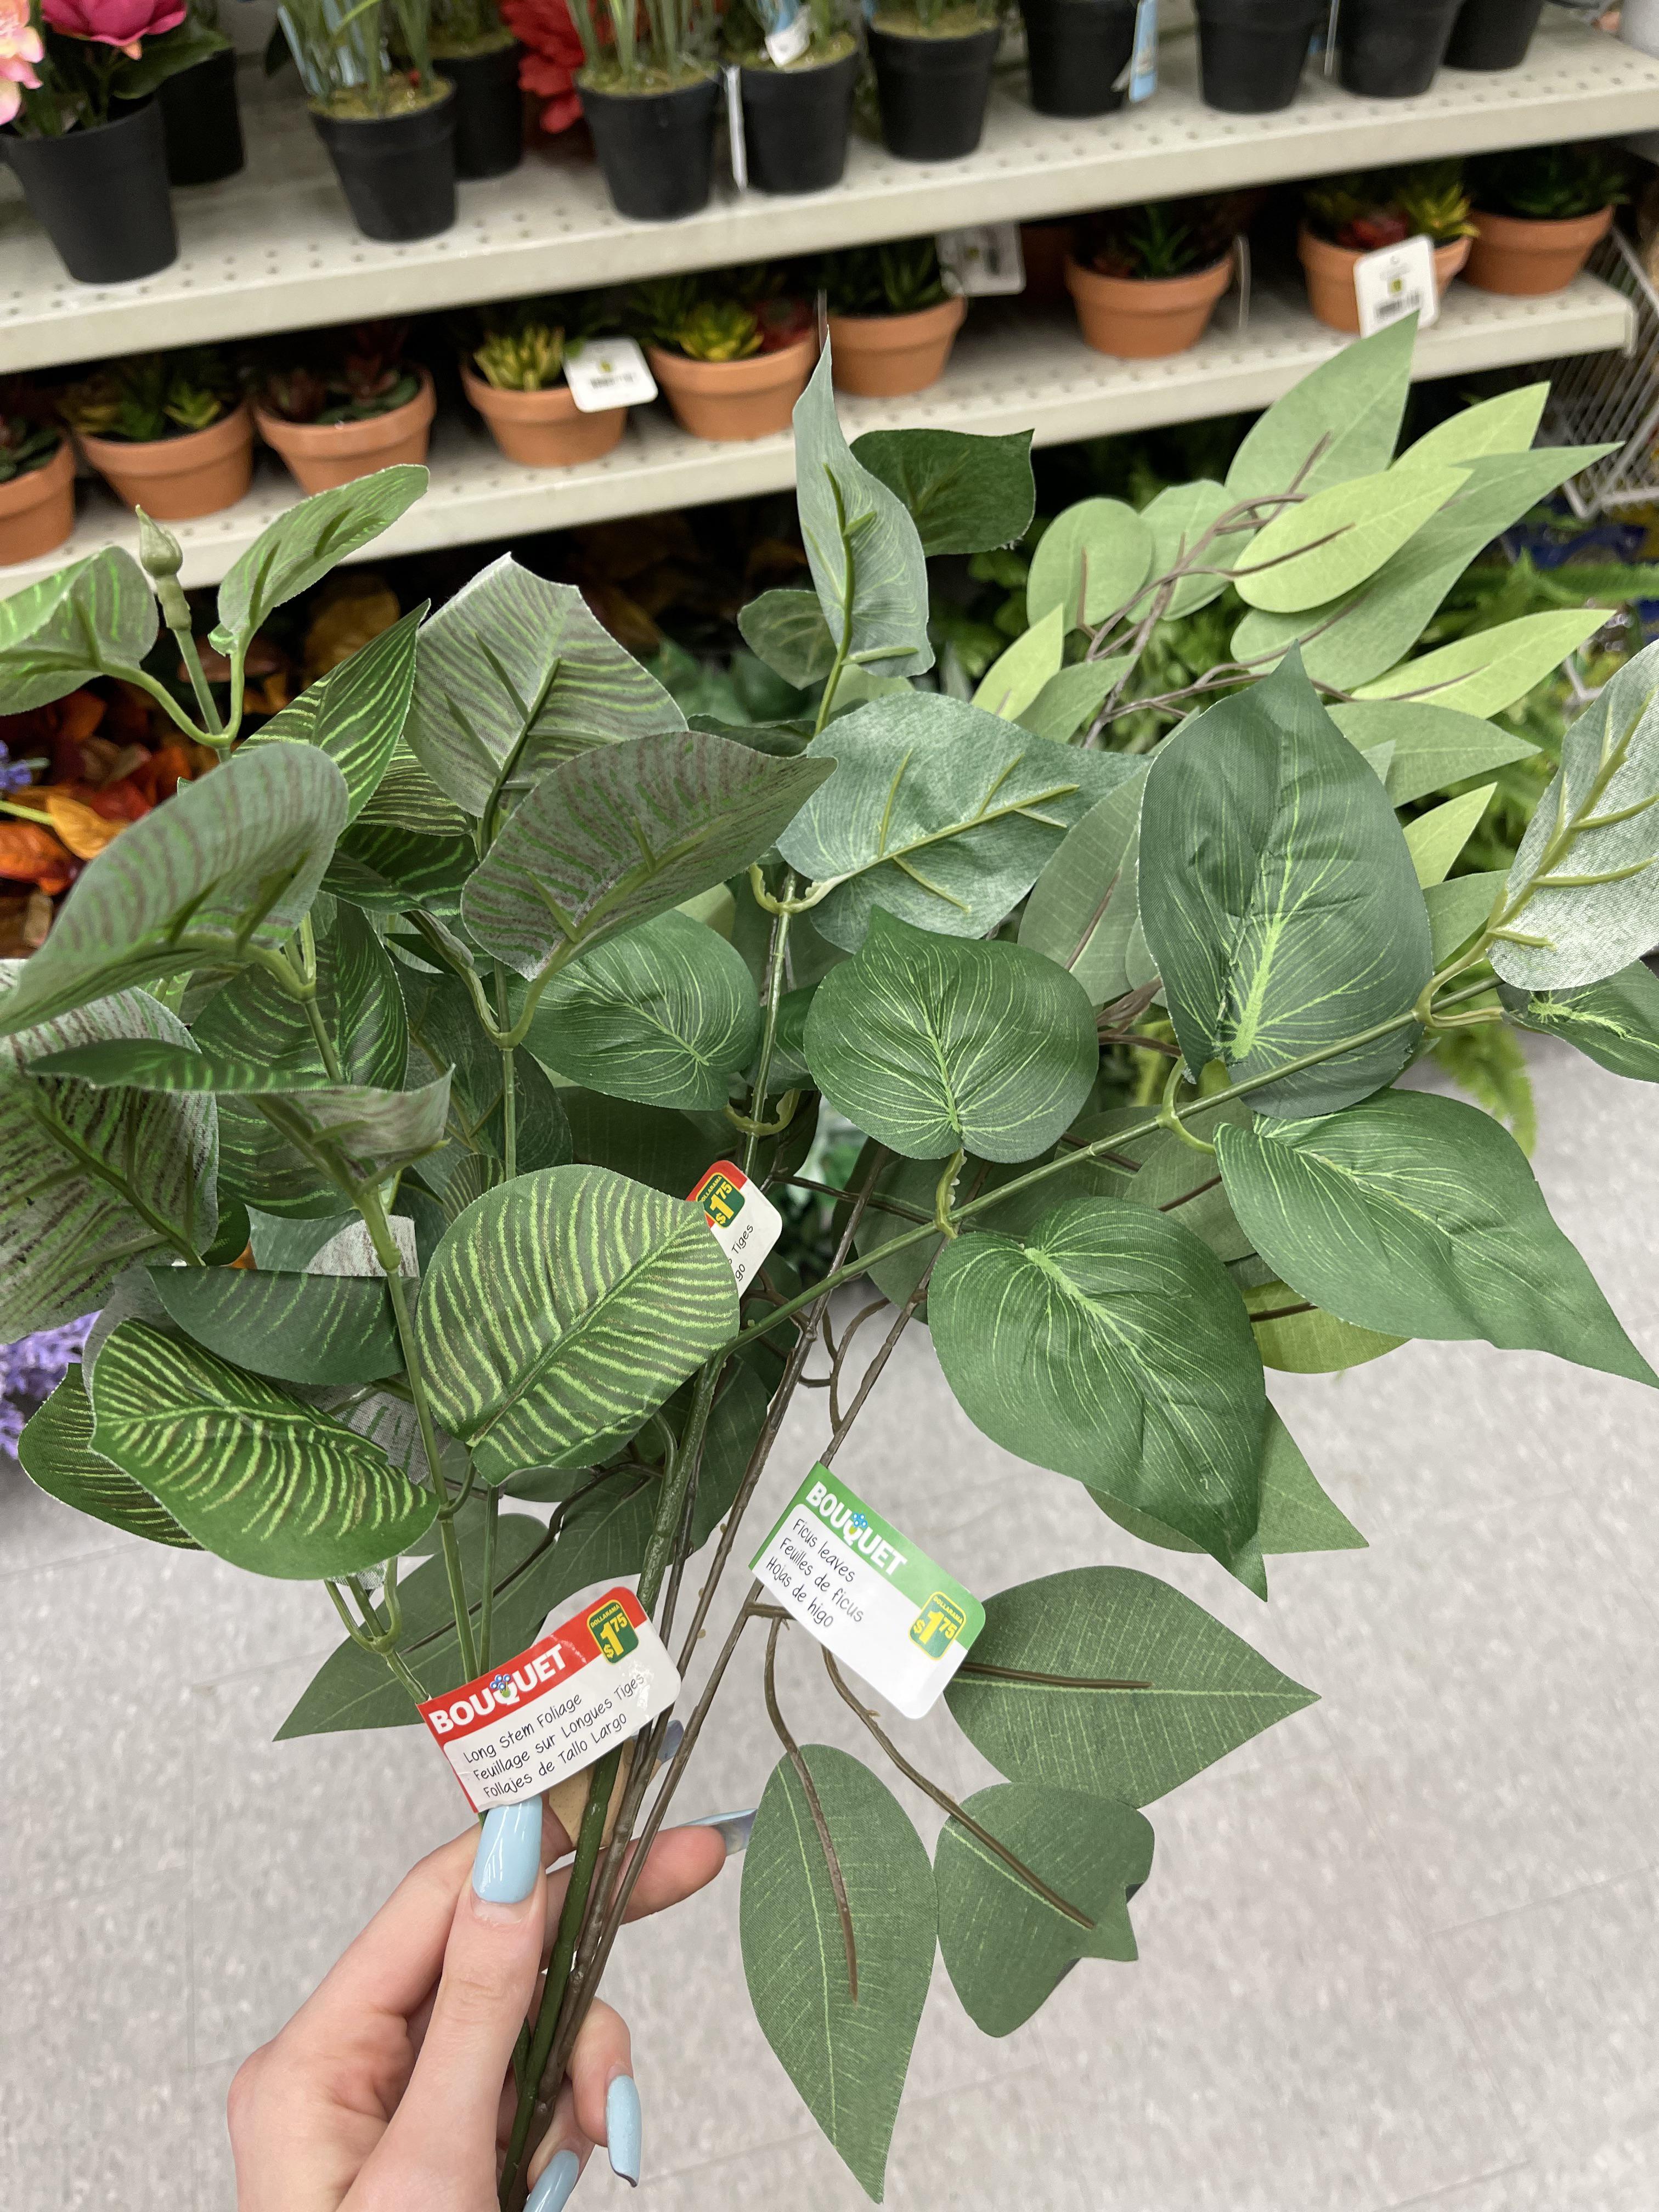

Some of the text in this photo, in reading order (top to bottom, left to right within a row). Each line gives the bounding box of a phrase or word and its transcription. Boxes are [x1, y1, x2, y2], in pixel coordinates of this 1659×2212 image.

[701, 1176, 722, 1202] OLLARAMA
[731, 1225, 753, 1254] Tiges
[793, 1519, 855, 1582] Ficus leaves
[805, 1481, 907, 1576] BOUQUET
[766, 1556, 833, 1627] Hojas de higo
[780, 1538, 864, 1622] Feuilles de ficus
[933, 1596, 963, 1624] DOLLARAMA
[590, 1604, 620, 1628] DOLLARAMA
[428, 1644, 565, 1734] BOUQUET
[463, 1694, 582, 1763] Long Stem Foliage
[473, 1674, 644, 1781] Feuillage sur Longues Tiges
[483, 1713, 627, 1798] Follajes de Tallo Largo
